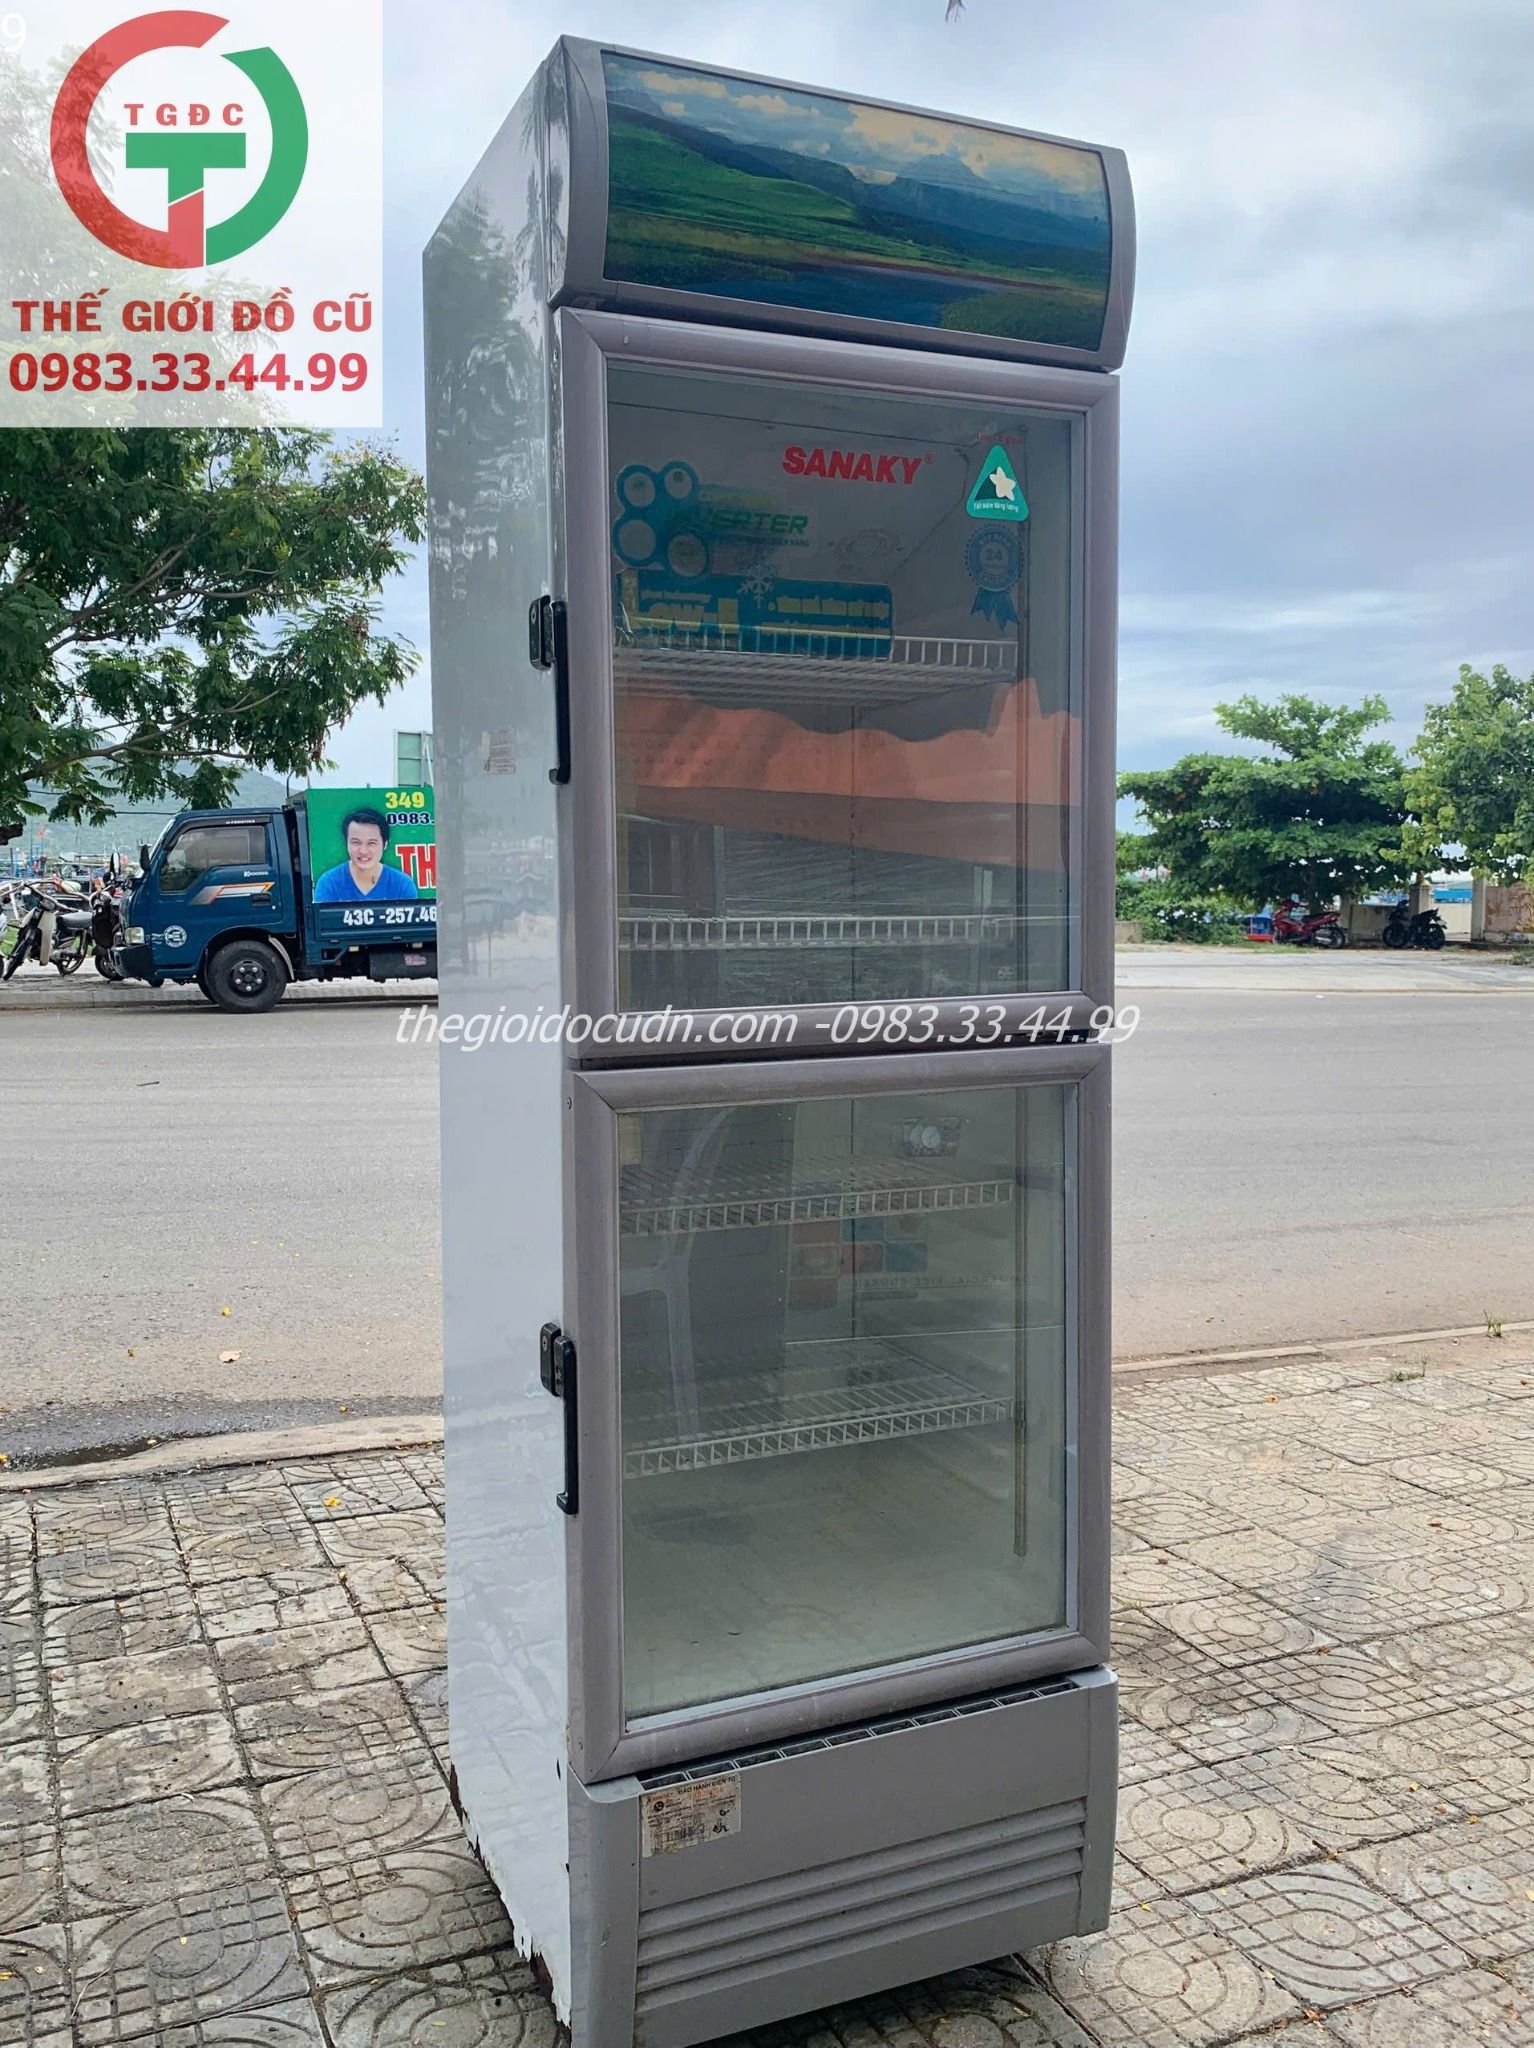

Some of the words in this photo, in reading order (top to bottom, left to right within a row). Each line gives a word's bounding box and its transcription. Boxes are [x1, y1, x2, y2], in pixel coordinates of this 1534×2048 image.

[782, 446, 922, 485] SANAKY
[385, 791, 425, 809] 349
[343, 908, 375, 926] 43C
